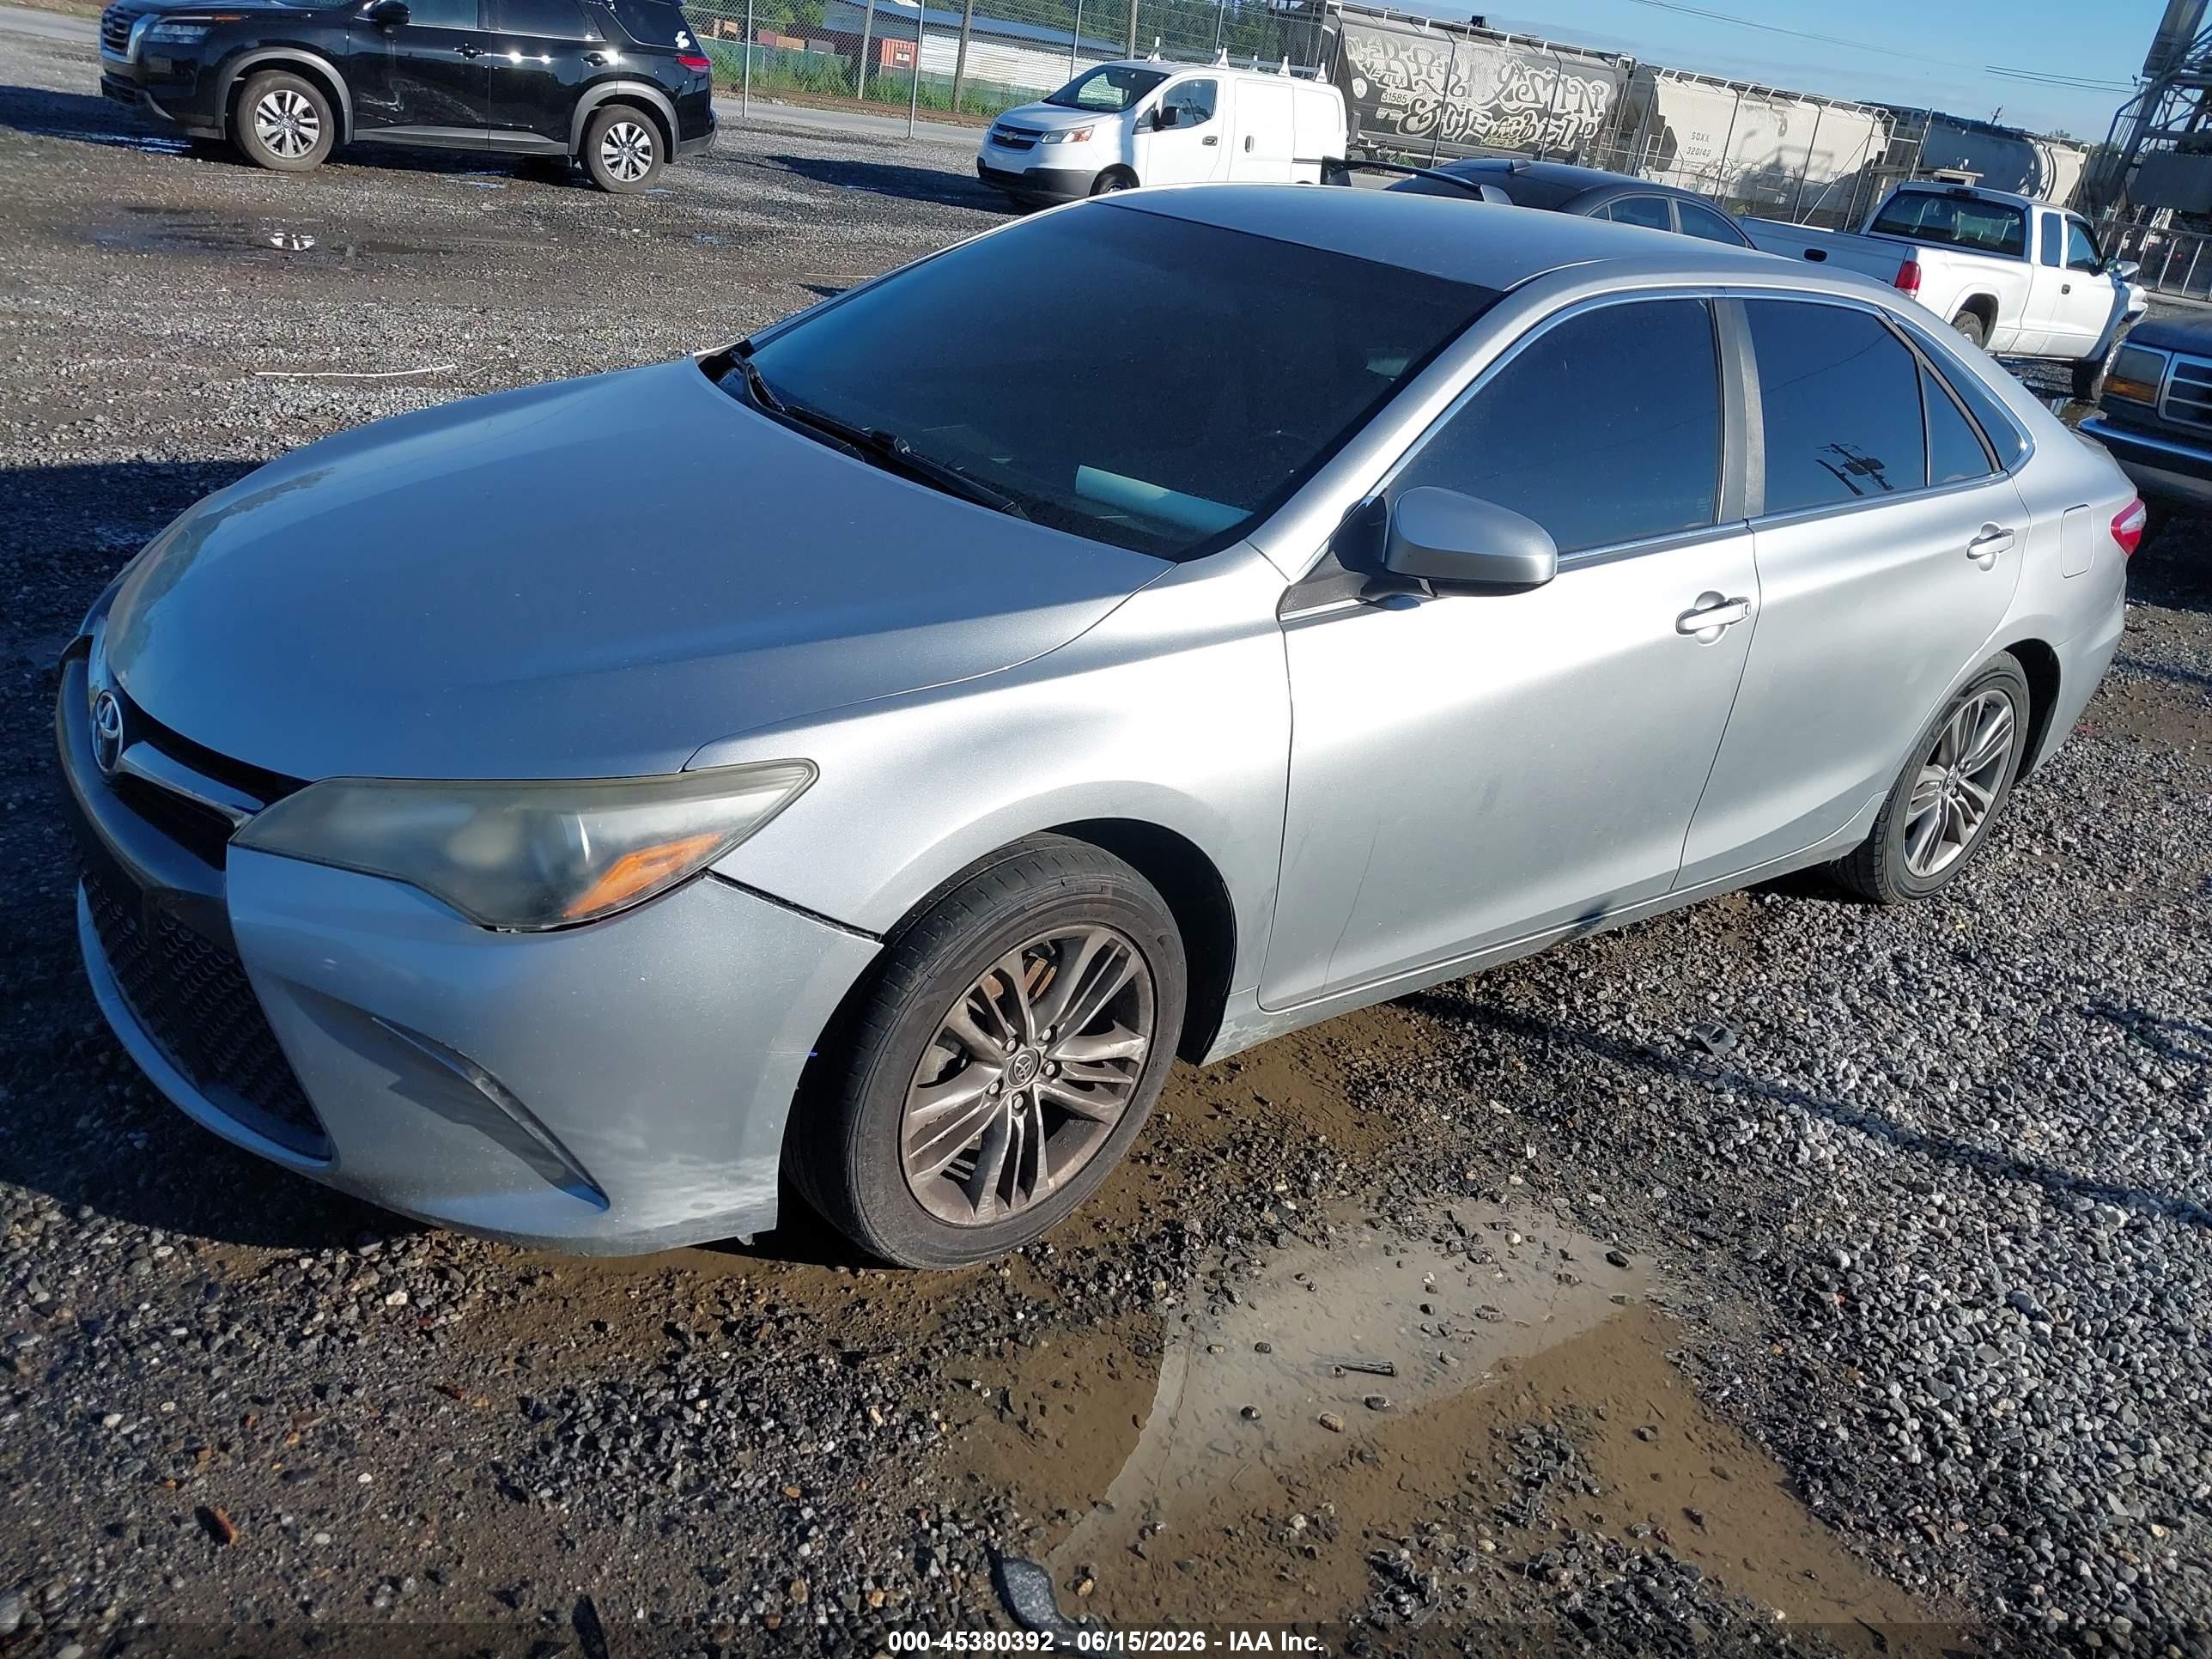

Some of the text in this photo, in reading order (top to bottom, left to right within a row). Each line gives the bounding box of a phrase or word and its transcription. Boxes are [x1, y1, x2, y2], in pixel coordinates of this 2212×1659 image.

[1387, 74, 1406, 86] TILX
[1382, 90, 1408, 103] 31585
[1691, 131, 1710, 143] SOXX
[1686, 146, 1711, 157] 320142
